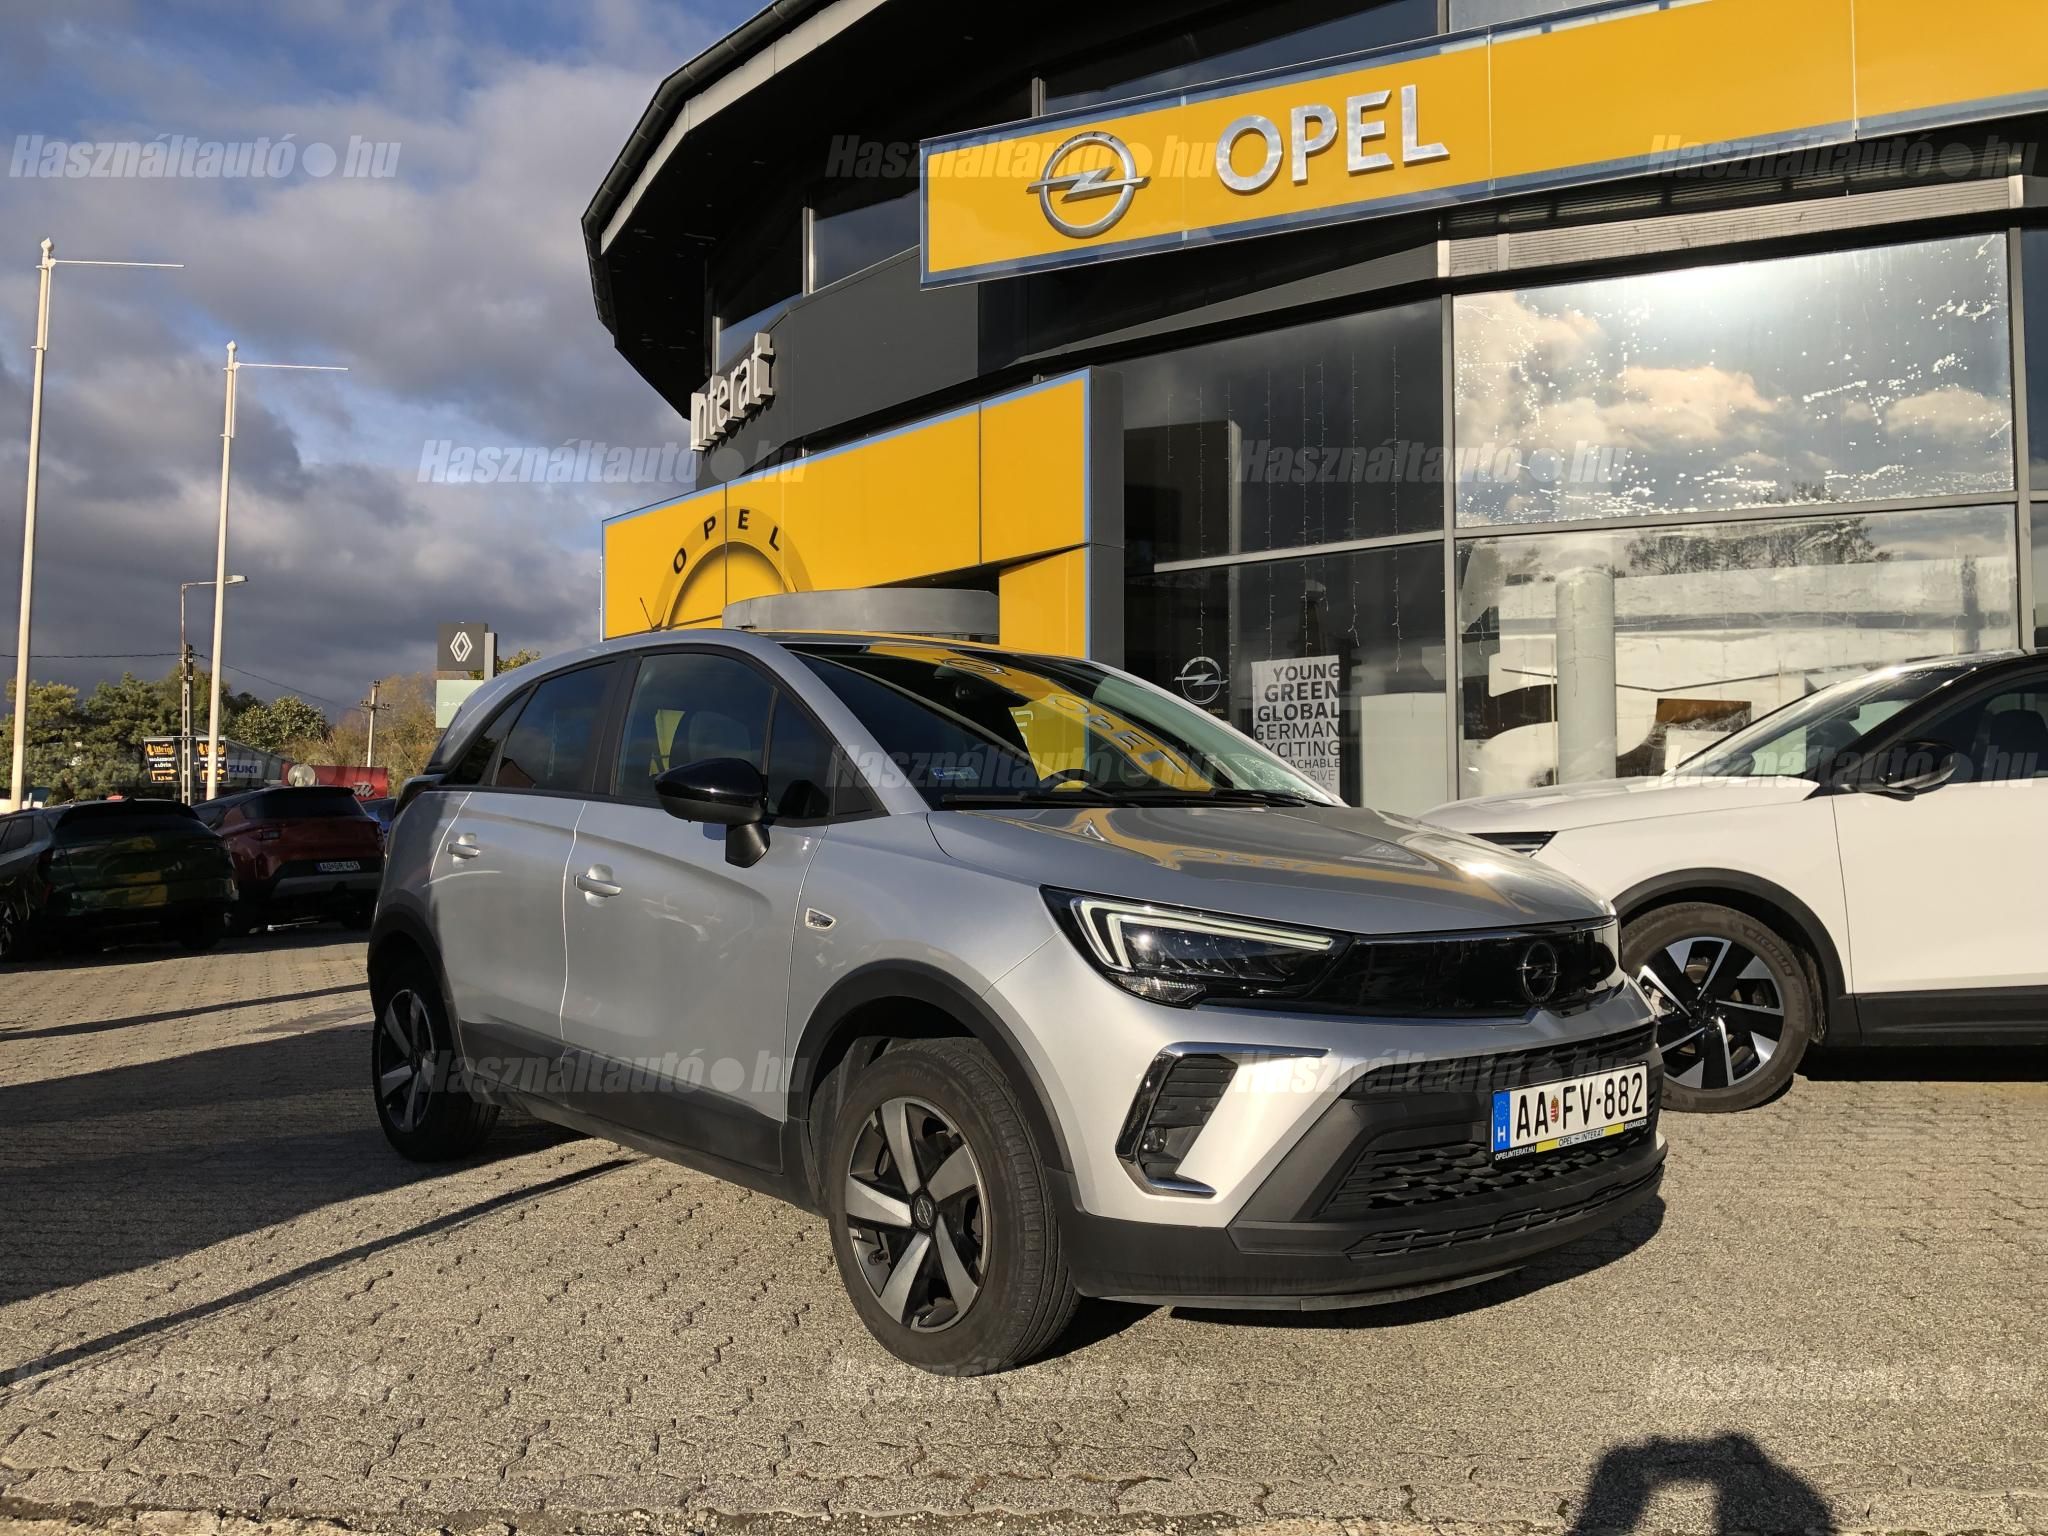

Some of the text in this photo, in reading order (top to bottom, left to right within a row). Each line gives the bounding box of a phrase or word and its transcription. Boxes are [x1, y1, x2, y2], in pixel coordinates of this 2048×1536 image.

[1216, 84, 1450, 193] OPEL
[673, 508, 780, 574] OPEL
[1273, 662, 1340, 682] YOUNG
[1264, 680, 1340, 702] GREEN
[1257, 702, 1340, 722] GLOBAL
[1254, 721, 1340, 740] GERMAN
[1262, 740, 1340, 757] XCITING
[228, 764, 258, 774] ZUKI
[1288, 758, 1340, 769] ACHABLE
[1497, 1126, 1507, 1143] H
